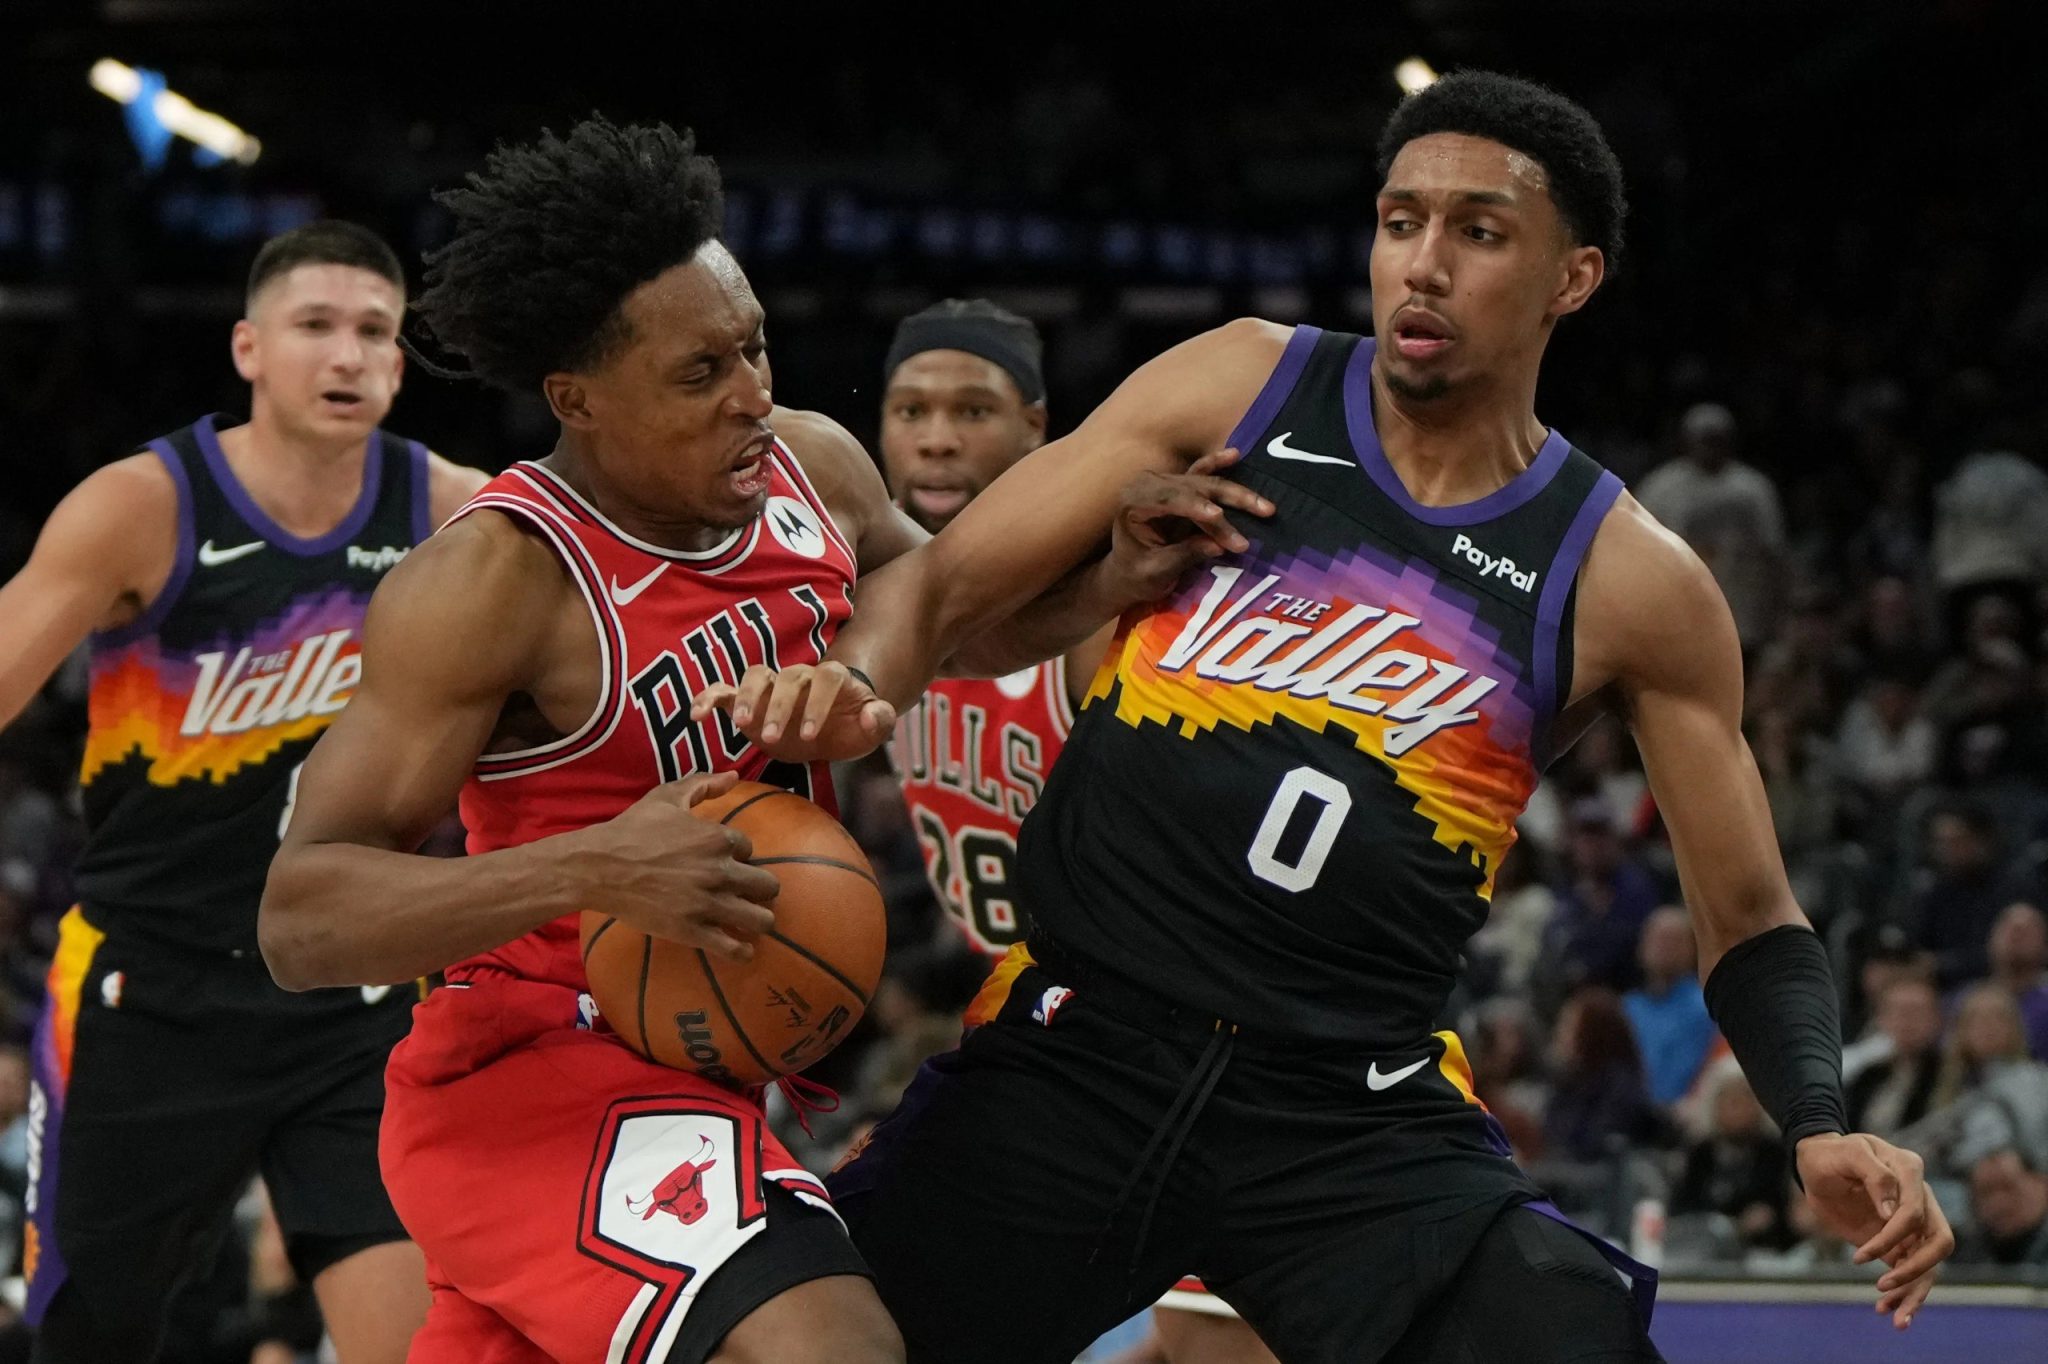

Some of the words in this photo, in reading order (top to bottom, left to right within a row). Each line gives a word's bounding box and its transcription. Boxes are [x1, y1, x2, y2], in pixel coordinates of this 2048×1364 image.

[346, 545, 411, 573] PayPa
[1452, 533, 1537, 594] PayPal
[1264, 592, 1332, 622] THE
[180, 629, 362, 737] Valle
[248, 650, 291, 676] THE
[1156, 565, 1499, 758] Valley
[886, 690, 1045, 823] ULLS
[1247, 765, 1352, 893] 0
